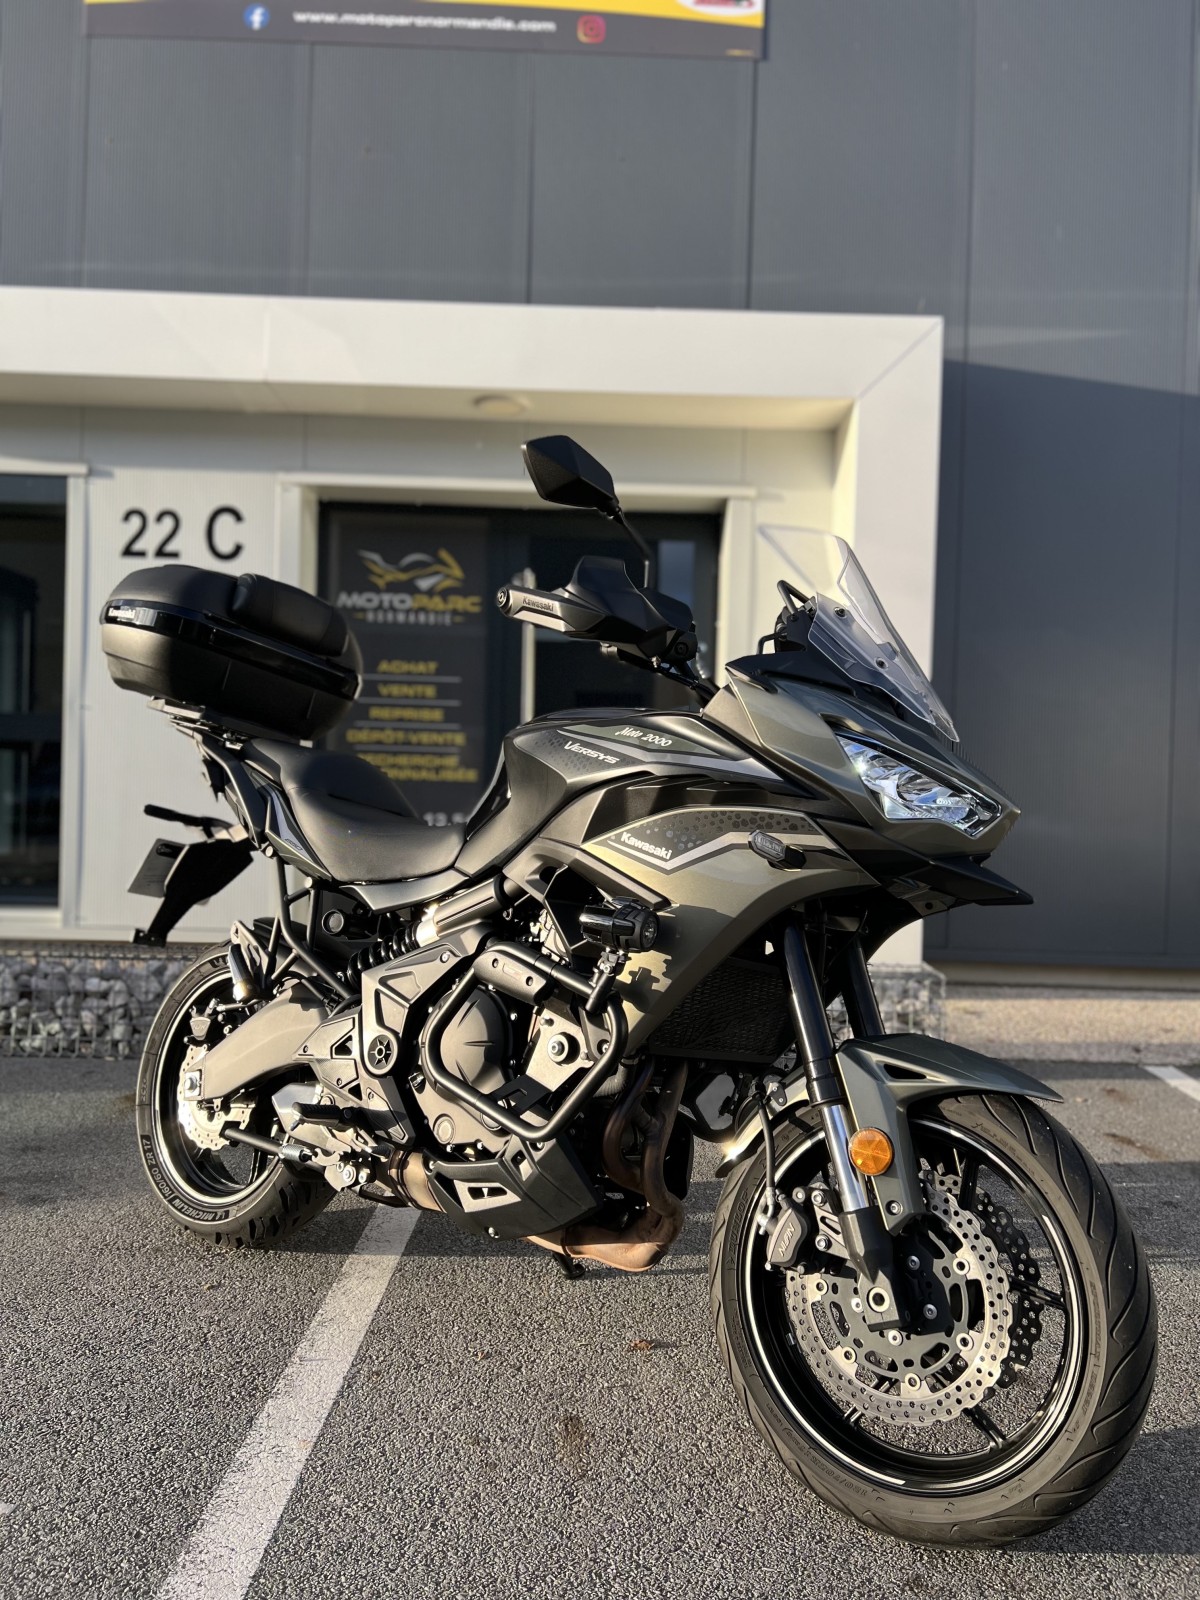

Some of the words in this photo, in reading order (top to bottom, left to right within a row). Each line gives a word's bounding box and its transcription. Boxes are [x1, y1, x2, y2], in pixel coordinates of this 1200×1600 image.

[121, 508, 181, 558] 22
[206, 505, 244, 560] C
[337, 591, 481, 613] MOTOPARC
[522, 596, 554, 612] Kawasaki
[377, 660, 438, 675] ACHAT
[378, 684, 437, 698] VENTE
[369, 707, 445, 722] REPRISE
[641, 733, 672, 747] 2000
[621, 832, 672, 860] Kawasaki
[142, 1138, 151, 1151] 17
[151, 1167, 172, 1198] 160/60
[172, 1198, 216, 1221] MICHELIN
